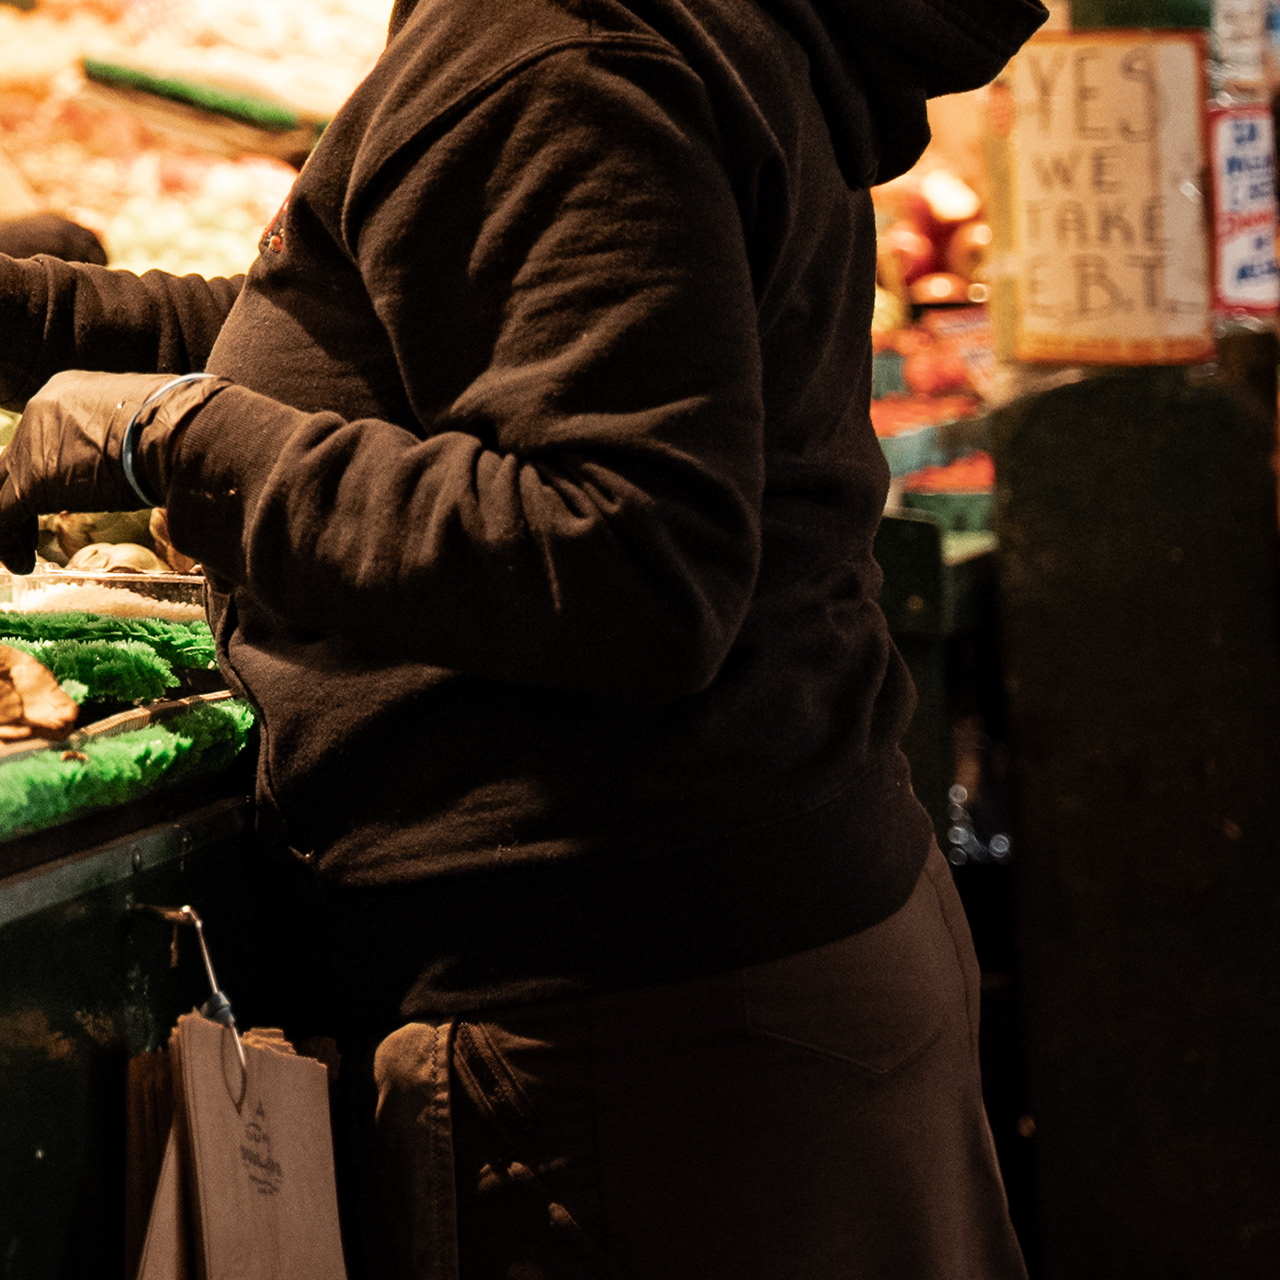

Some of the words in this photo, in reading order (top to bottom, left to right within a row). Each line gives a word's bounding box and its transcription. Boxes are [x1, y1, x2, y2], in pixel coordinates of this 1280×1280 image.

[1018, 47, 1164, 144] YES
[1028, 144, 1124, 194] WE
[1025, 197, 1170, 250] TAKE
